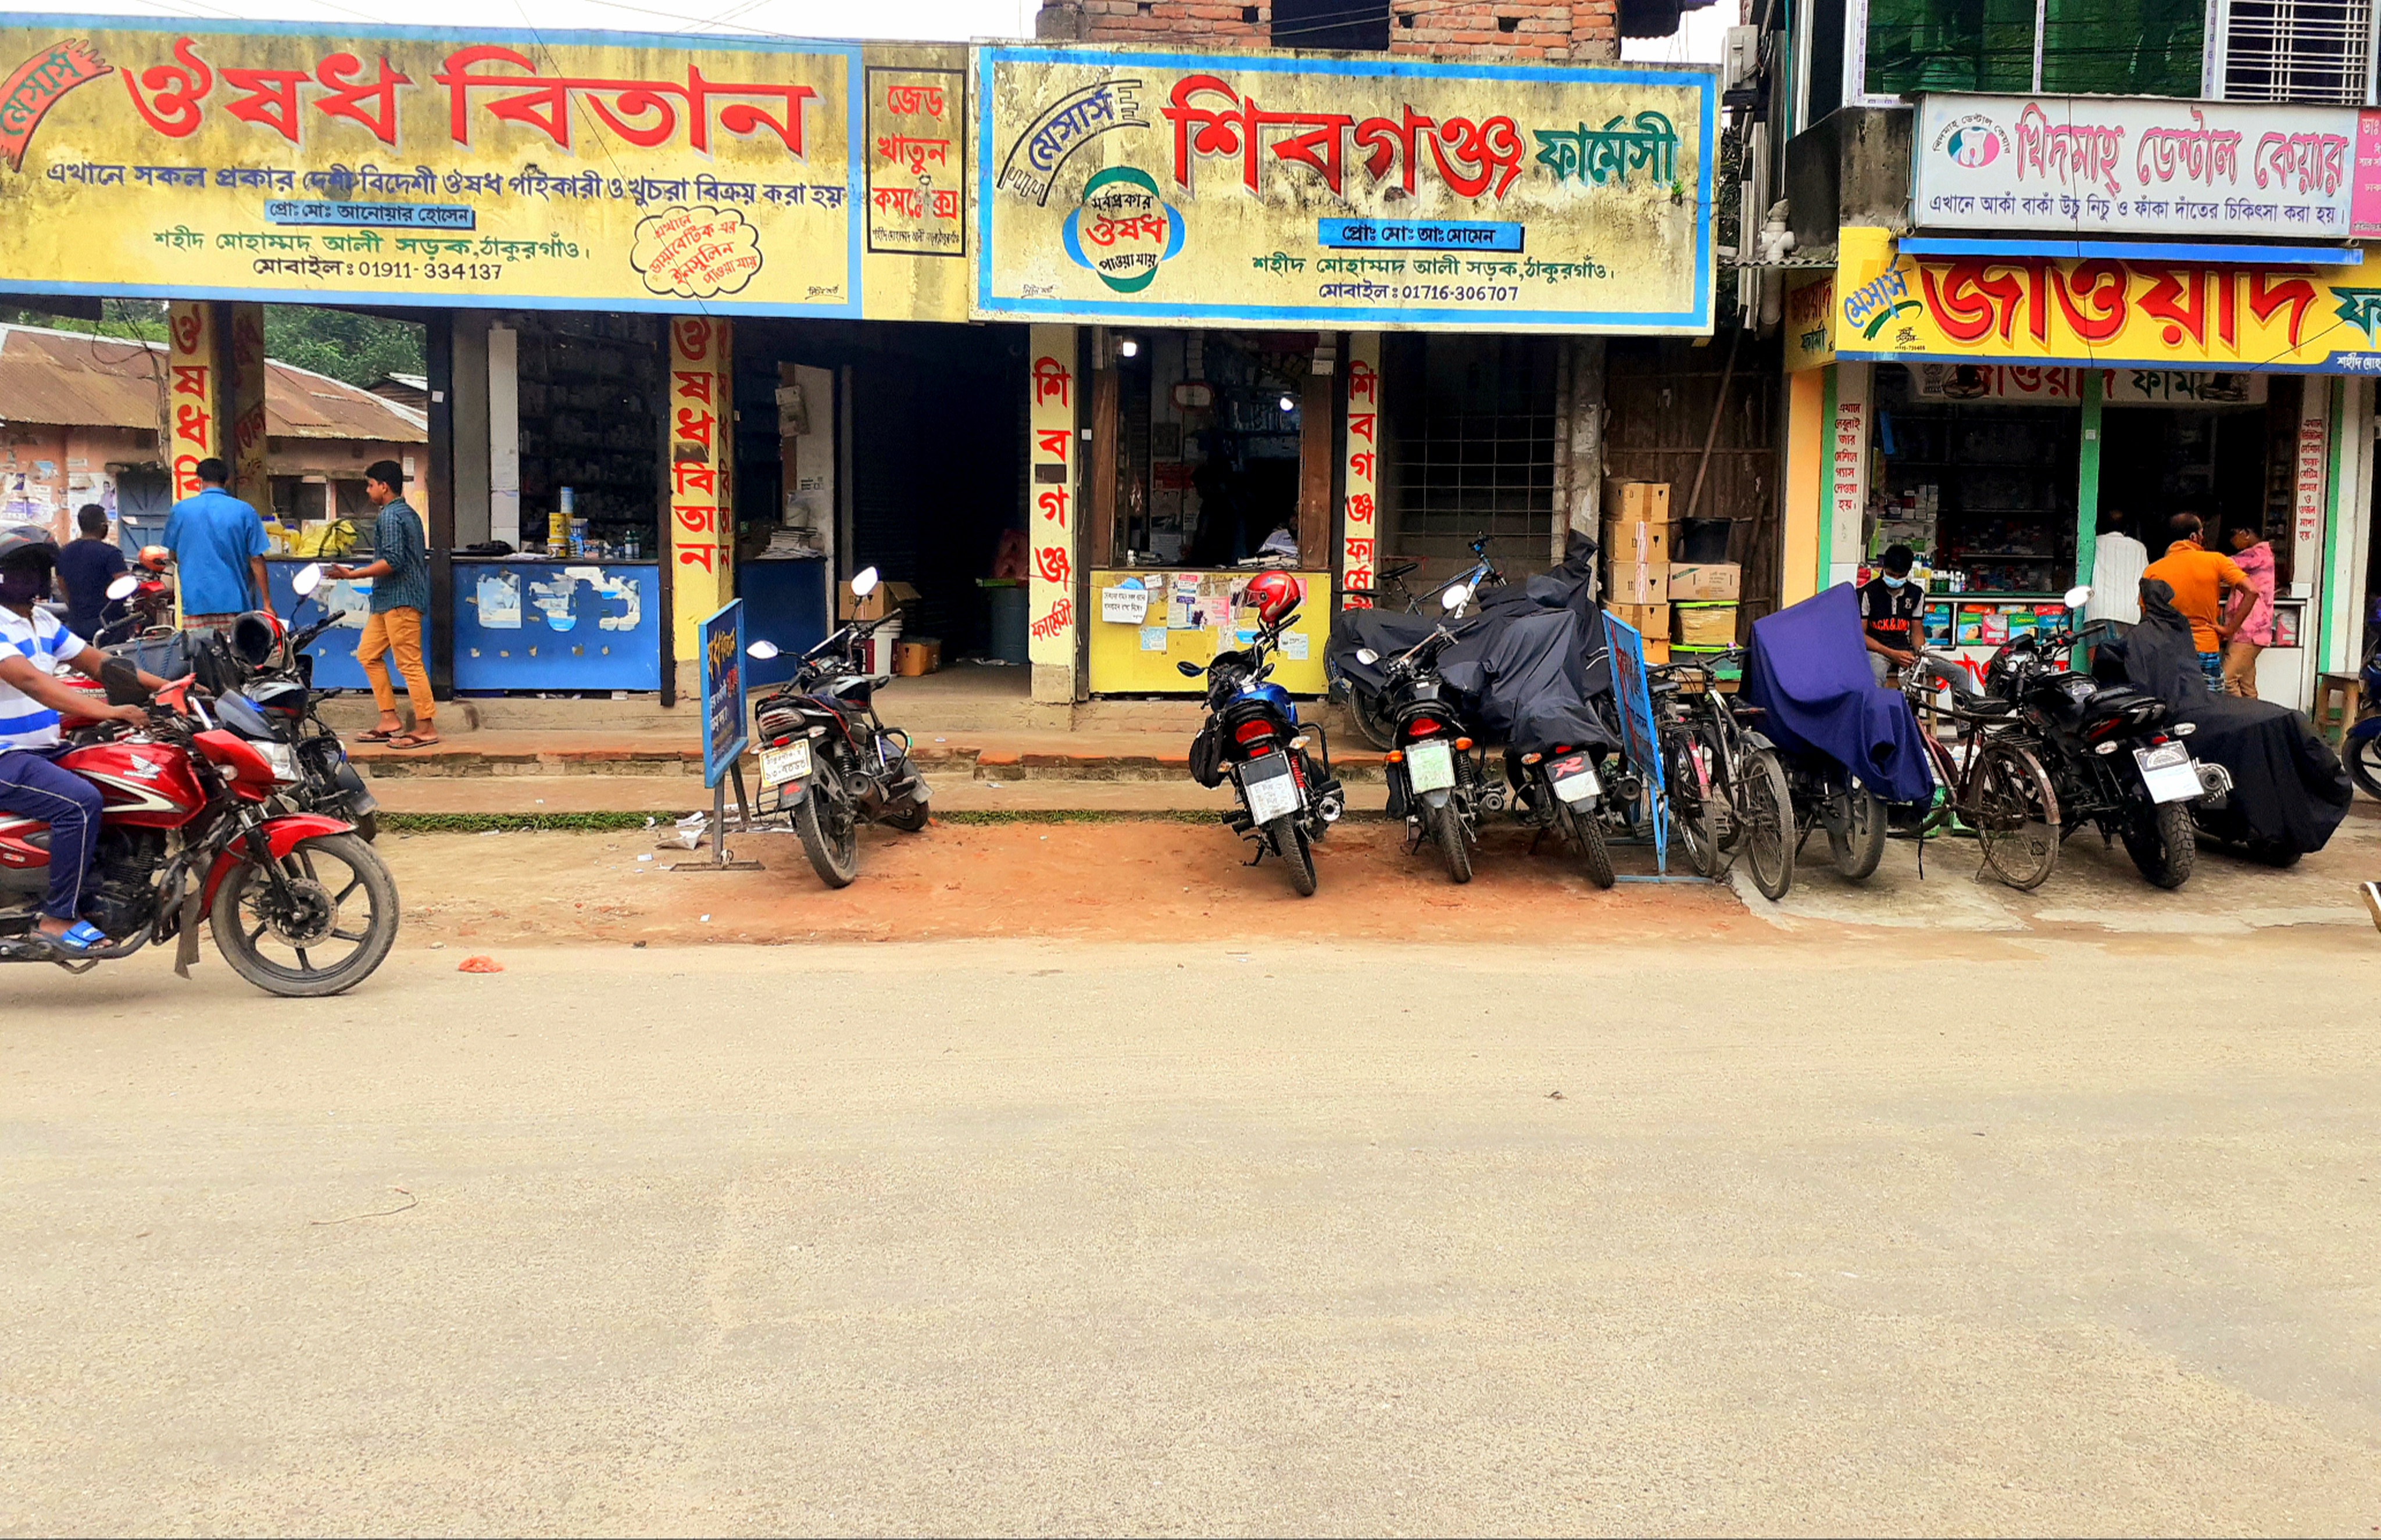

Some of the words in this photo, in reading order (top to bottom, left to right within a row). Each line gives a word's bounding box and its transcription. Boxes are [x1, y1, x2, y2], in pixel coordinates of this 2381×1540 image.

[120, 37, 413, 147] ঔষধ
[432, 45, 818, 158] বিতান
[1029, 87, 1114, 171] মেসার্স
[1160, 74, 1524, 202] শিবগঞ্জ
[1533, 111, 1680, 185] ফার্মেসী
[878, 132, 950, 174] খাতুন
[2136, 105, 2242, 186] ডেন্টাল
[2254, 131, 2350, 197] কেয়ার
[47, 161, 126, 186] এখানে
[133, 166, 207, 188] সকল
[215, 166, 295, 192] প্রকার
[442, 169, 503, 196] ঔষধ
[607, 178, 623, 199] ও
[628, 176, 689, 206] খুচরা
[694, 174, 756, 206] বিক্রয়
[763, 182, 806, 206] করা
[810, 185, 845, 209] হয়
[338, 206, 413, 222] আনোয়ার
[419, 207, 470, 224] হোসেন
[1930, 194, 1975, 214] এখানে
[2086, 194, 2110, 223] নিচু
[2117, 203, 2127, 216] ও
[2175, 196, 2218, 221] দাঁতের
[2224, 198, 2278, 221] চিকিৎসা
[2284, 205, 2310, 223] করা
[153, 225, 204, 251] শহীদ
[215, 231, 312, 253] মোহাম্মদ
[322, 230, 383, 253] আলী
[1086, 213, 1167, 246] ঔষধ
[1447, 228, 1496, 244] মোমেন
[1099, 253, 1134, 271] পাওয়া
[1135, 253, 1159, 269] যায়
[1253, 252, 1307, 277] শহীদ
[1316, 256, 1406, 277] মোহাম্মদ
[1414, 254, 1460, 276] আলী
[1835, 467, 1854, 478] গ্যাস
[1833, 484, 1857, 495] দেওয়া
[1031, 599, 1073, 642] ফার্মেসী
